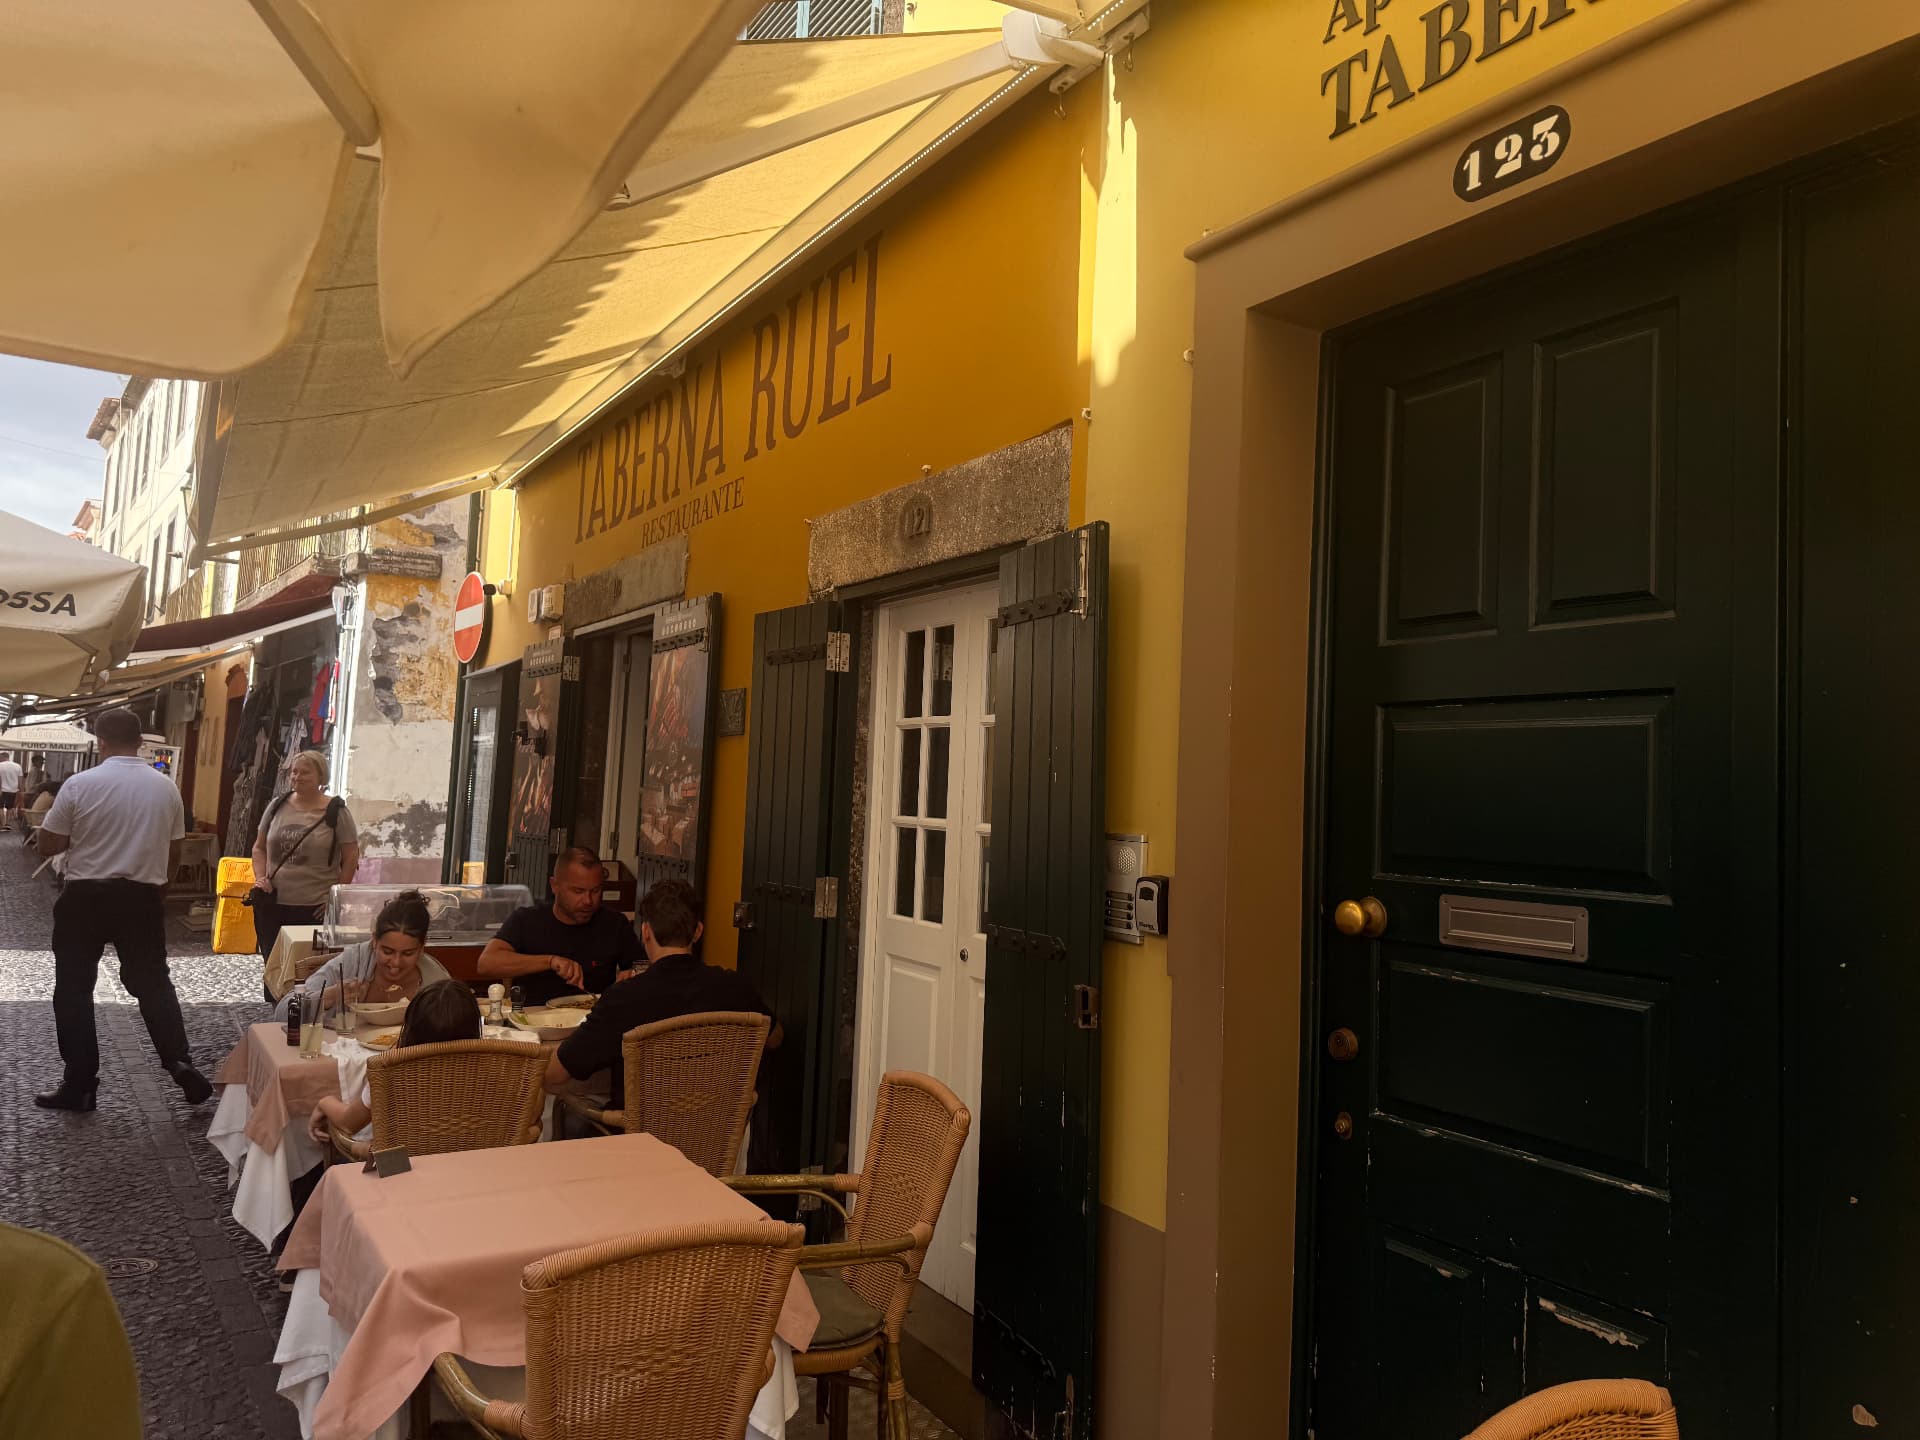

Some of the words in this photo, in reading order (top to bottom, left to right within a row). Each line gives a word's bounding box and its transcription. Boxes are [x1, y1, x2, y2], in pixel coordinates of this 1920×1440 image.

[1463, 114, 1560, 191] 123
[575, 349, 726, 544] TABERNA
[744, 229, 892, 462] RUEL
[641, 476, 745, 549] RESTAURANTE
